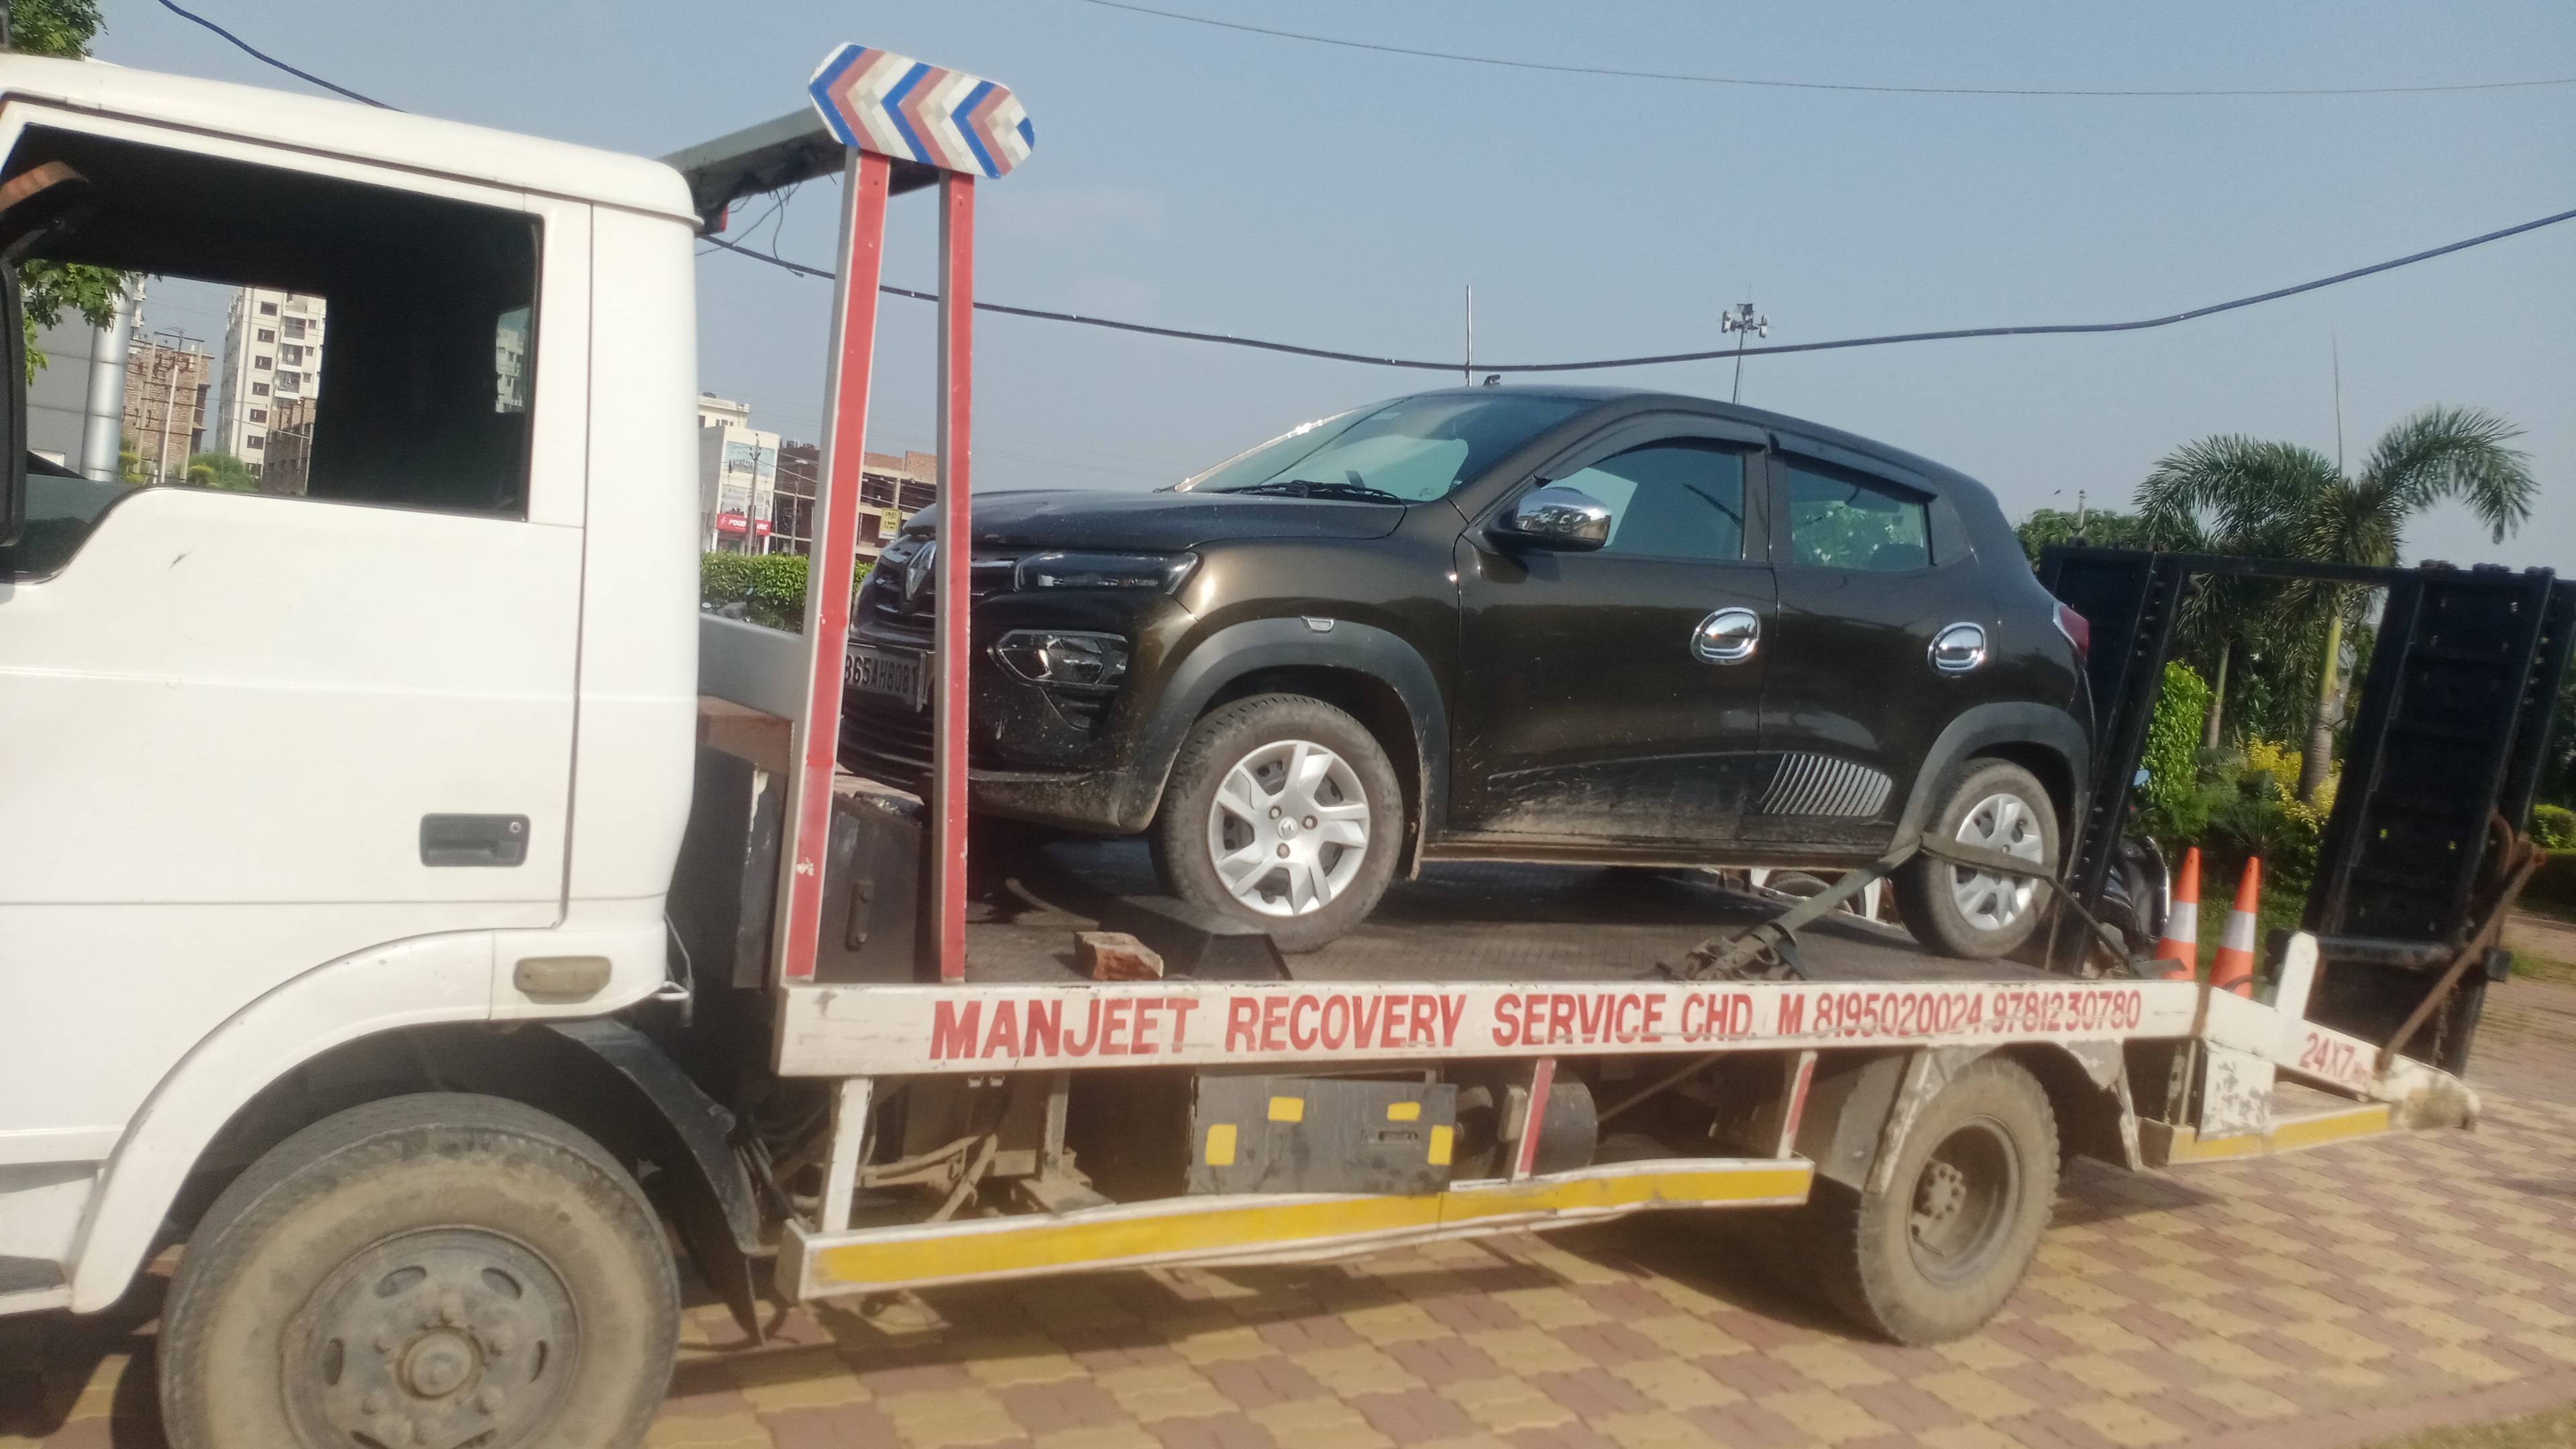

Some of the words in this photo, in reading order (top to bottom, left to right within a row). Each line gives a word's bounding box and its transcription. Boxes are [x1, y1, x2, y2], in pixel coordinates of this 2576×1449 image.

[729, 519, 747, 527] FOOD
[929, 997, 1199, 1059] MANJEET
[1224, 994, 1467, 1051] RECOVERY
[1492, 993, 1666, 1046] SERVICE
[2298, 1031, 2355, 1077] 24X7
